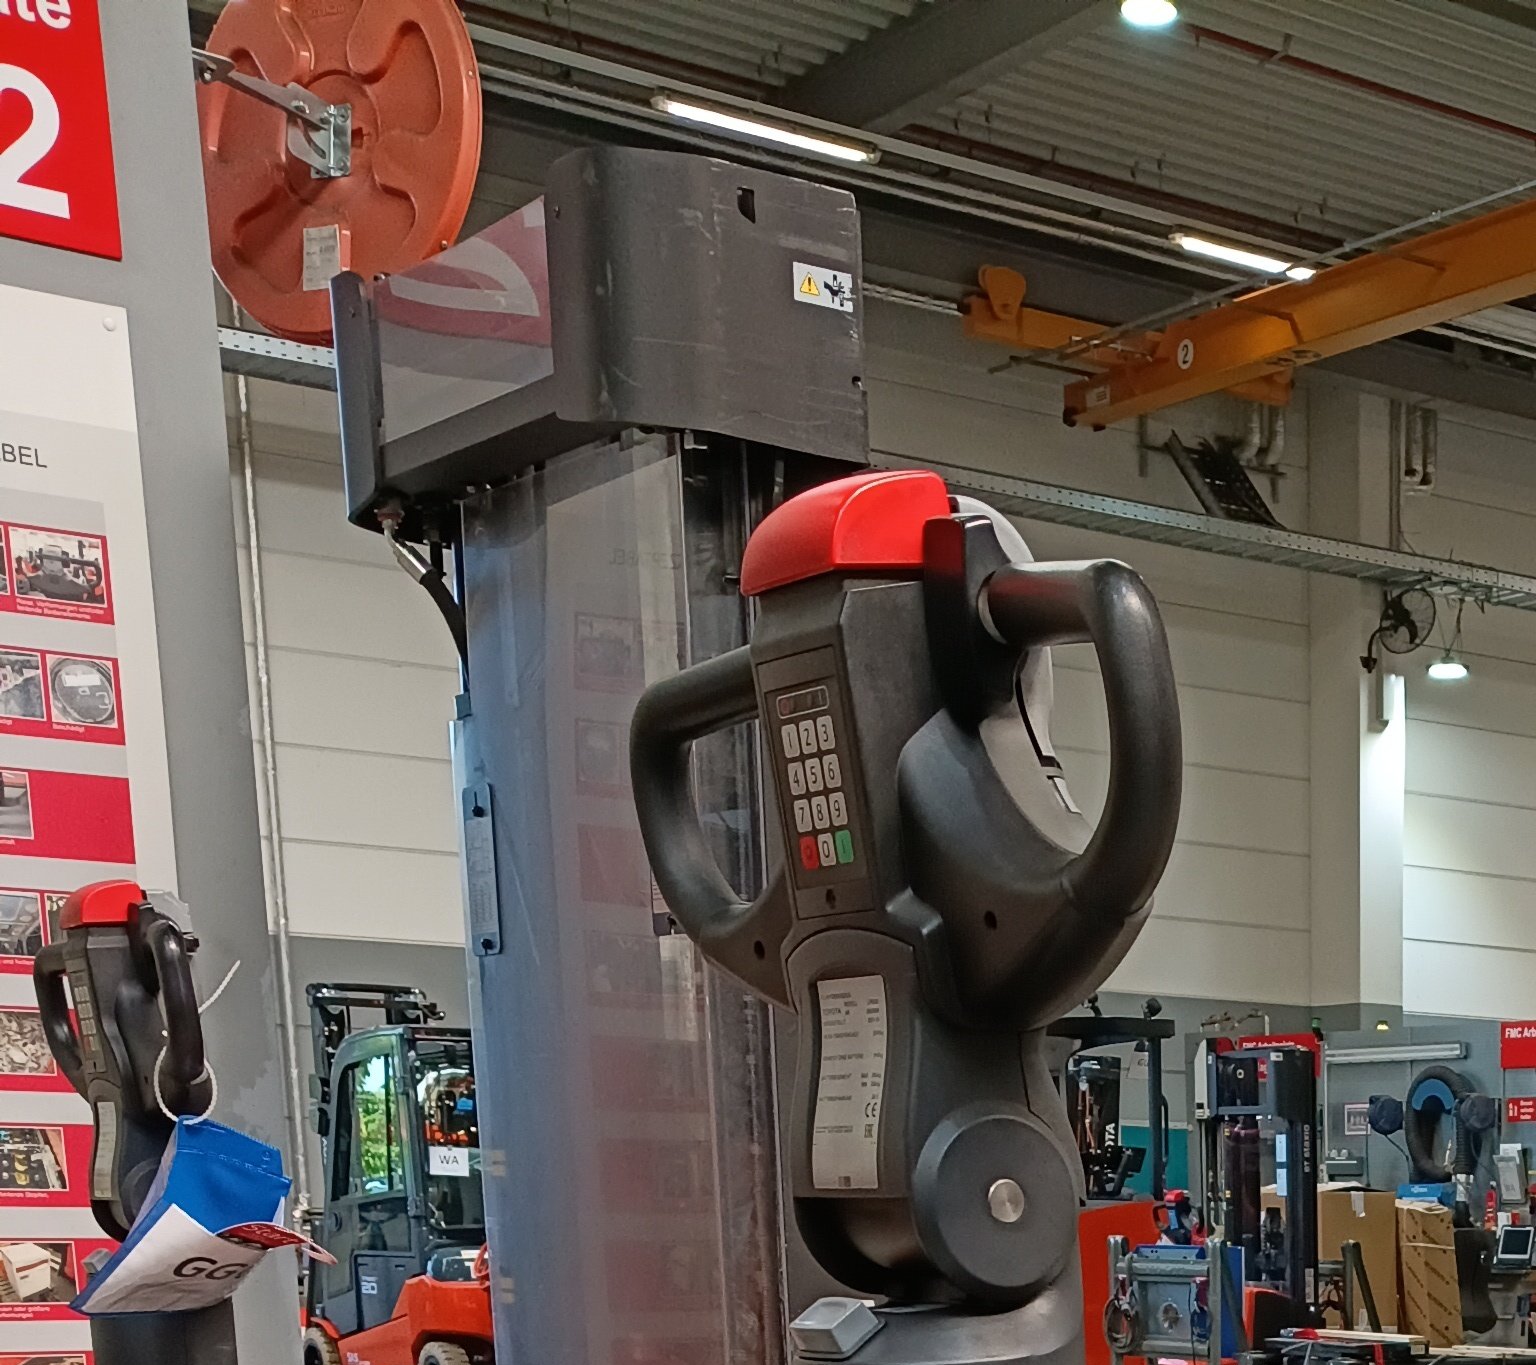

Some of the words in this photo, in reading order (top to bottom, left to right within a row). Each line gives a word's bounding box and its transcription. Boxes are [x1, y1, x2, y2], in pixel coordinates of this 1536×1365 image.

[1182, 344, 1189, 364] 2
[0, 443, 47, 468] BEL
[787, 731, 793, 750] 1
[804, 728, 812, 746] 2
[822, 724, 829, 742] 3
[793, 769, 800, 787] 4
[810, 765, 818, 784] 5
[828, 762, 835, 780] 6
[799, 807, 805, 824] 7
[816, 803, 824, 821] 8
[834, 800, 841, 818] 9
[1505, 1027, 1521, 1039] FMC
[438, 1154, 459, 1166] WA
[173, 1257, 249, 1281] GG
